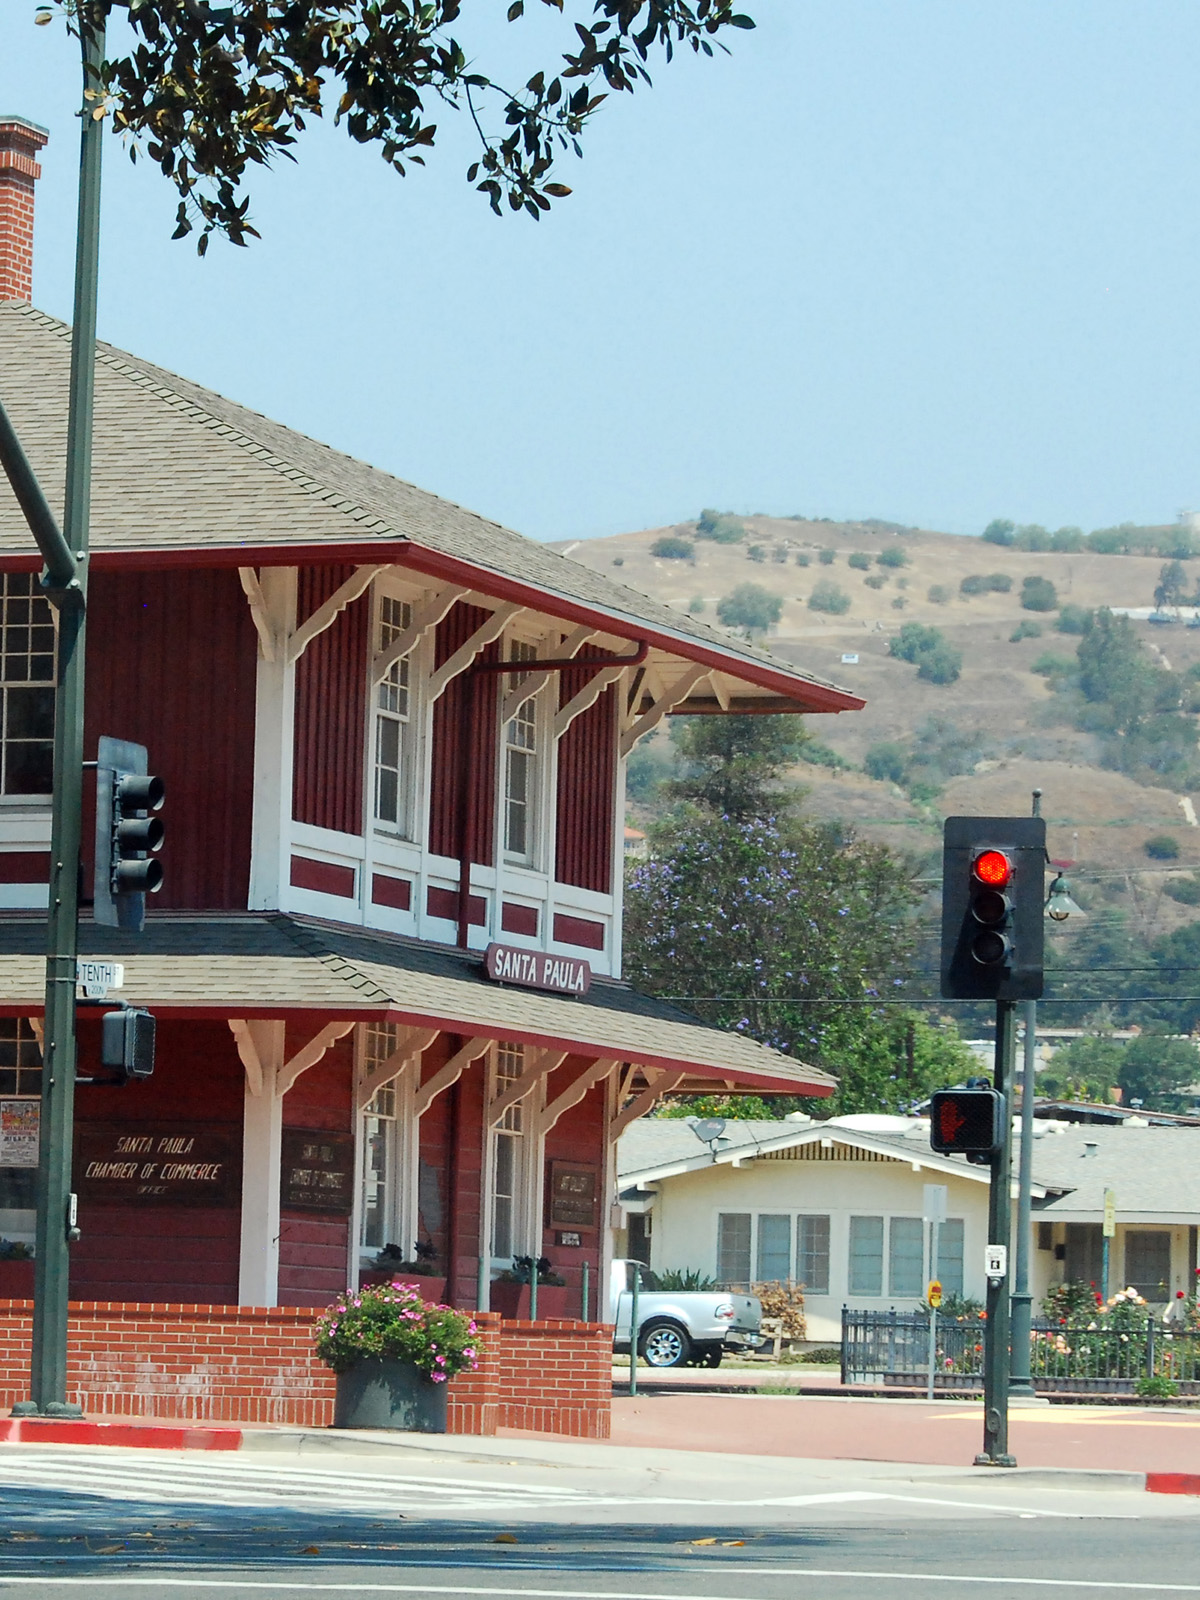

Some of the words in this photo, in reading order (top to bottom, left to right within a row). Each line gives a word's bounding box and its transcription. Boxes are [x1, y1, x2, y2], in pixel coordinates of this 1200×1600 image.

[82, 964, 112, 983] TENTH
[494, 948, 537, 982] SANTA
[543, 958, 585, 991] PAULA
[114, 1136, 153, 1153] SANTA
[156, 1137, 195, 1154] PAULA
[85, 1161, 138, 1179] CHAMBER
[140, 1162, 159, 1179] OF
[160, 1163, 222, 1180] COMMERCE
